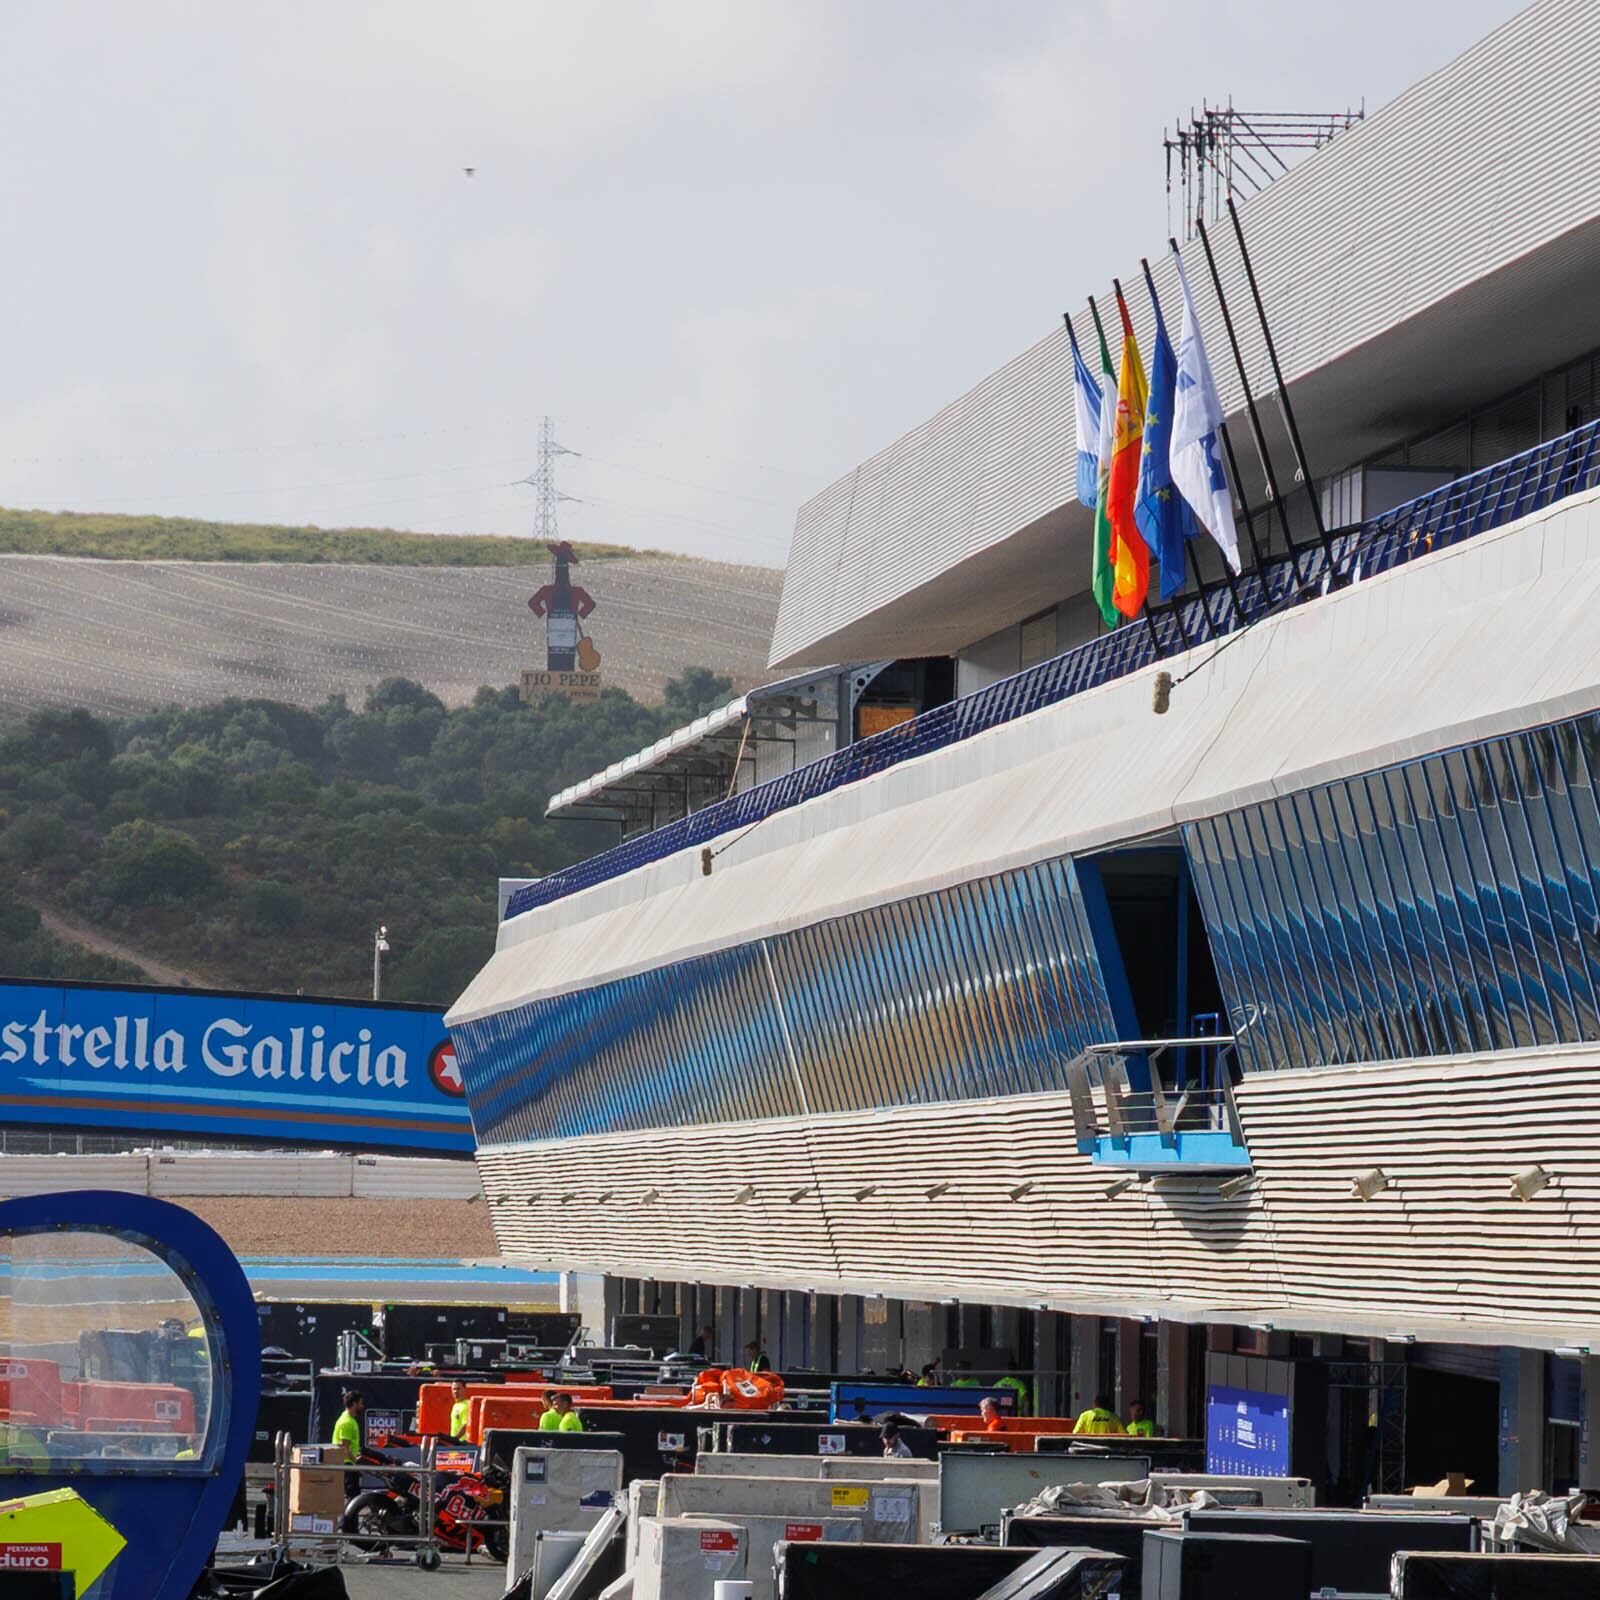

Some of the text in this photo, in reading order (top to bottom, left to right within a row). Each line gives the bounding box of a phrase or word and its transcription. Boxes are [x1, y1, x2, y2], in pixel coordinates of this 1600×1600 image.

[202, 1018, 408, 1088] Galicia
[368, 1417, 396, 1427] LIQUI
[368, 1428, 396, 1437] MOLY
